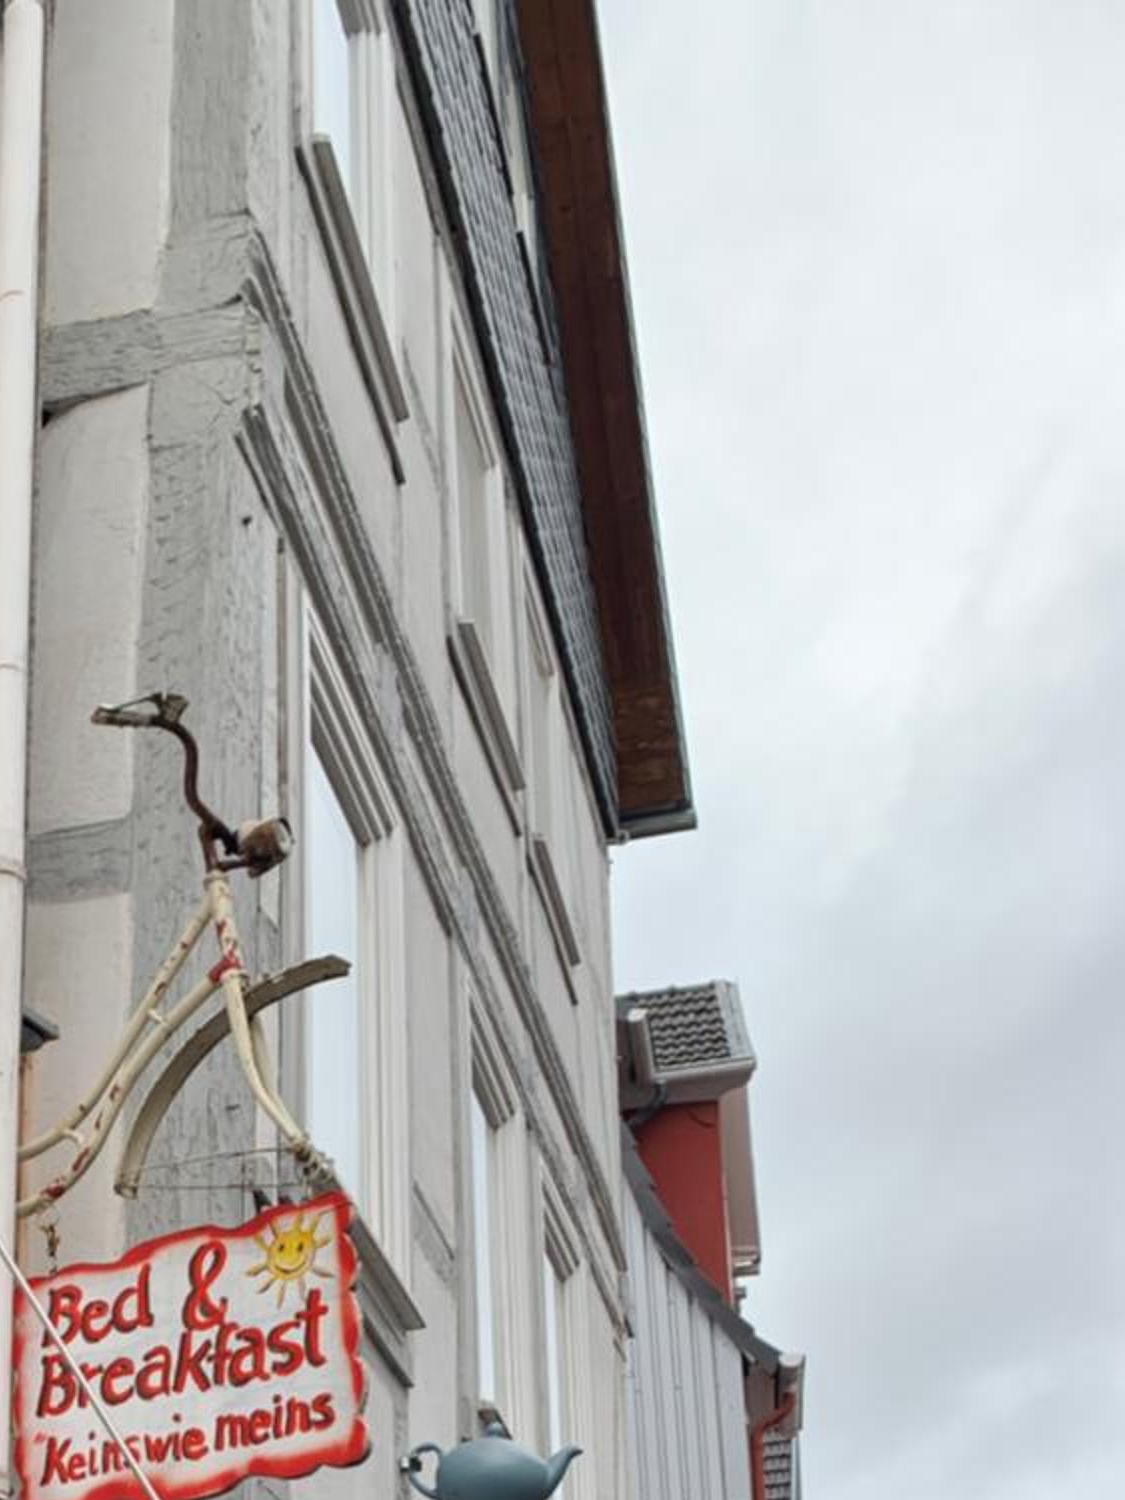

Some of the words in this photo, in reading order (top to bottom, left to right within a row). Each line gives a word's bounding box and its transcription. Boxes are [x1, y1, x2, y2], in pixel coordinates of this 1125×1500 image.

[42, 1263, 154, 1348] Bed
[182, 1240, 227, 1331] &
[37, 1288, 328, 1418] Breakfast
[144, 1413, 209, 1463] wie
[215, 1392, 336, 1451] meins
